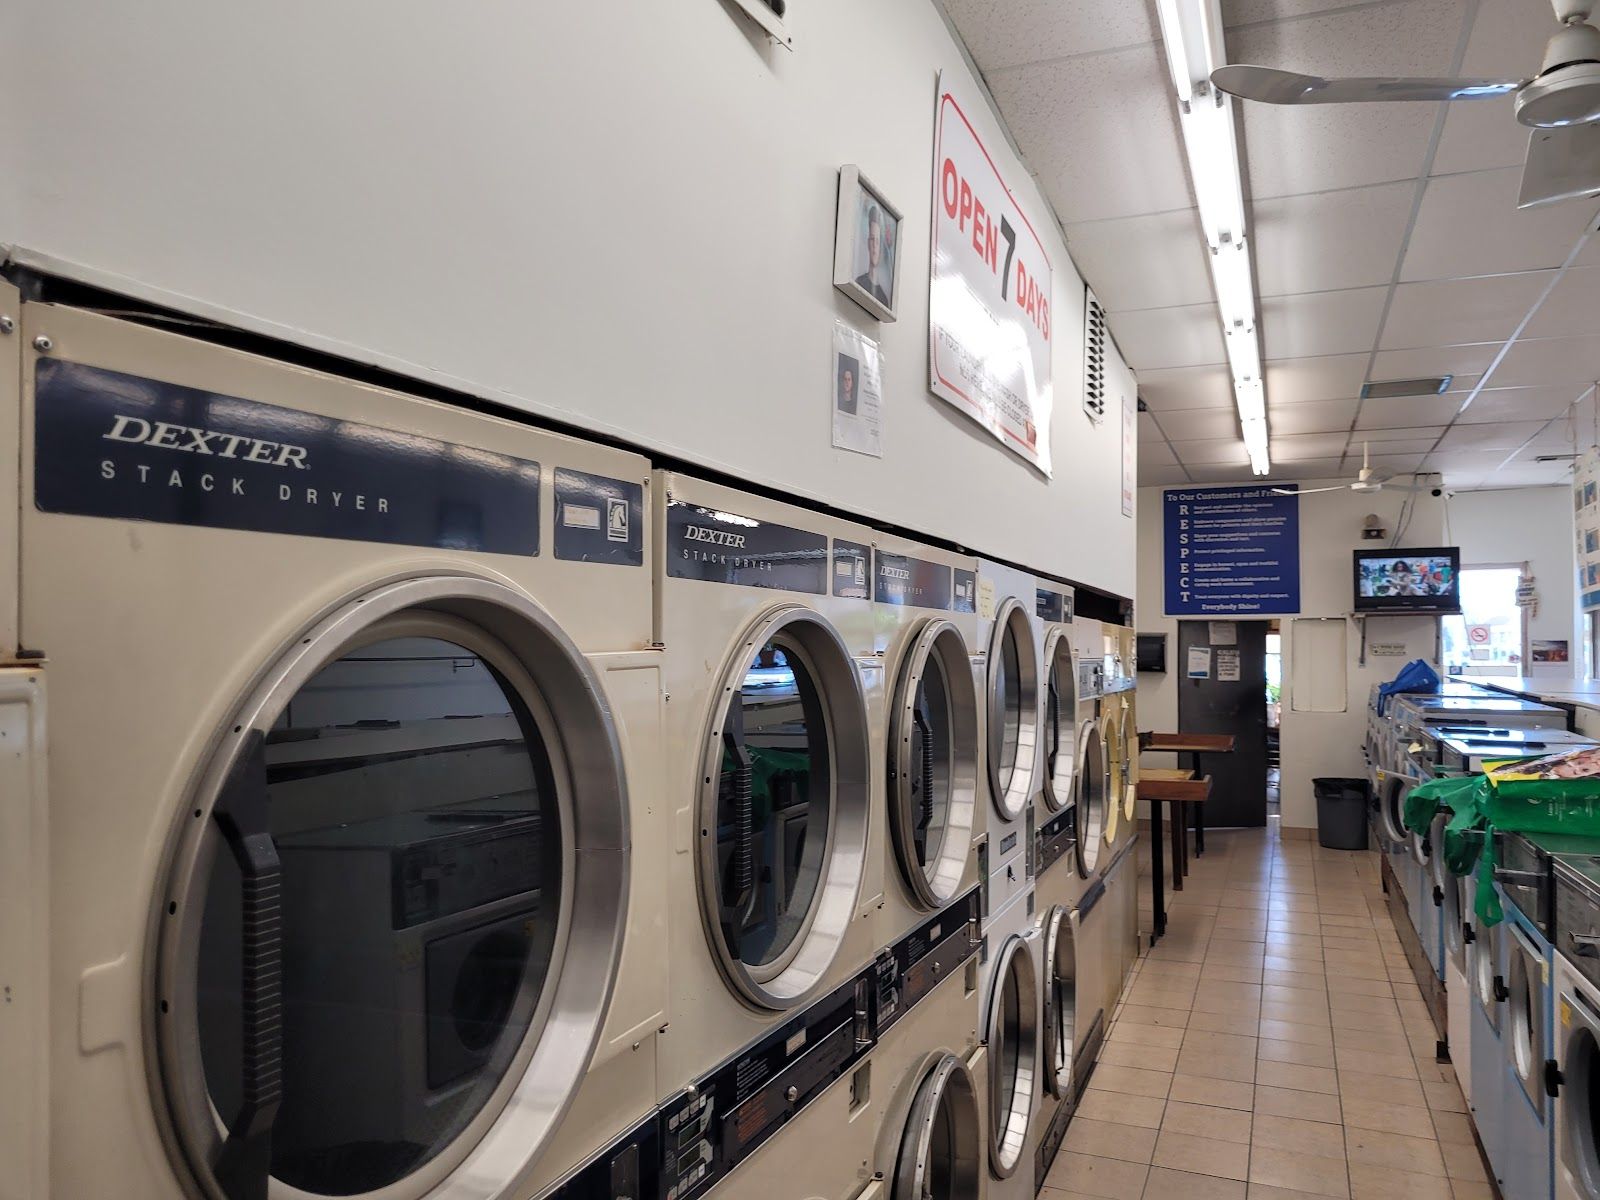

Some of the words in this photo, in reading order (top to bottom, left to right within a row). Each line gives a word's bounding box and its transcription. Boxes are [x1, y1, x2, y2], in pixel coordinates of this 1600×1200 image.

[942, 157, 998, 275] OPEN
[1001, 213, 1016, 301] 7
[1016, 258, 1049, 341] DAYS
[102, 414, 308, 470] DEXTER
[101, 460, 244, 495] STACK
[279, 484, 389, 513] DRYER
[1167, 494, 1177, 502] To
[1179, 493, 1194, 501] Our
[1196, 492, 1241, 500] Customers
[1243, 490, 1259, 498] and
[684, 525, 746, 549] DEXTER
[683, 549, 725, 565] STACK
[735, 557, 772, 572] DRYER
[880, 565, 910, 580] DEXTER
